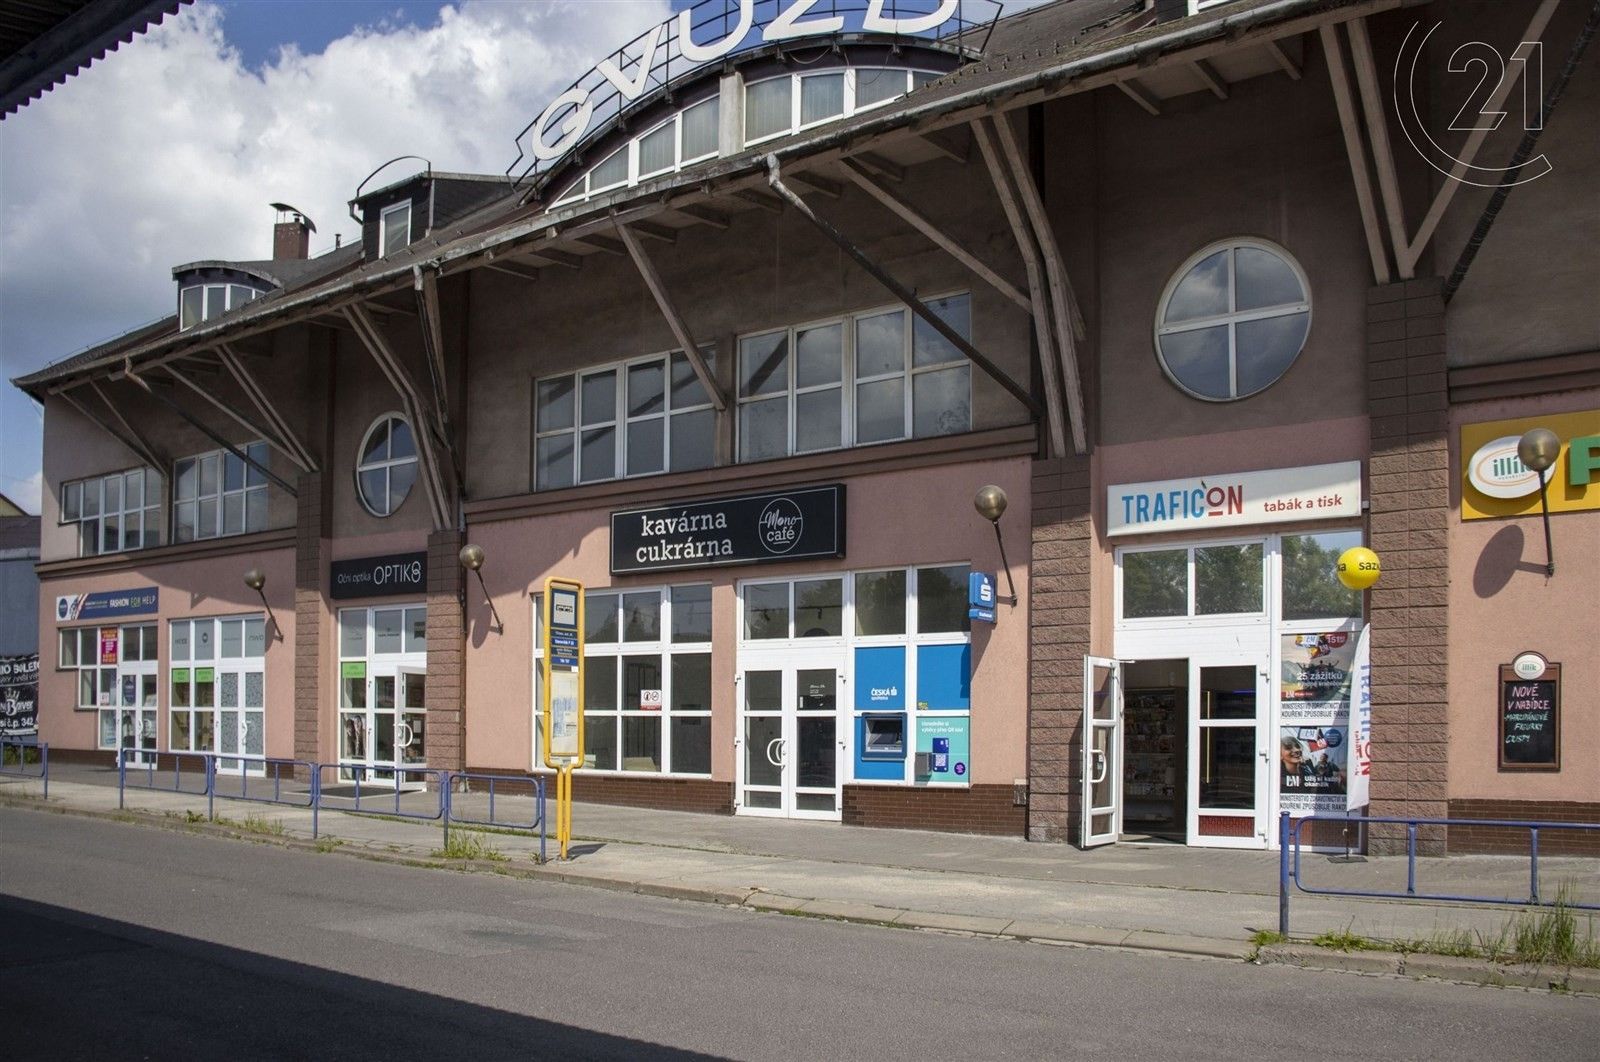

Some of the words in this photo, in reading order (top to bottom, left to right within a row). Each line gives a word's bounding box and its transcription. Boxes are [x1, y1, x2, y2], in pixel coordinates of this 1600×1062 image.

[1264, 498, 1302, 513] tabák
[1306, 500, 1314, 509] a
[1317, 494, 1343, 508] tisk
[641, 511, 727, 537] kavárna
[764, 509, 800, 530] Mono
[767, 528, 795, 541] café
[636, 538, 733, 563] cukrárna
[353, 570, 371, 584] optika
[110, 598, 129, 607] FASHION
[142, 595, 155, 604] HELP
[1296, 672, 1308, 681] 25
[1310, 671, 1343, 681] zážitků
[871, 687, 891, 696] ČESKÁ
[1507, 701, 1515, 711] V
[1515, 697, 1551, 710] NABÍDCE
[21, 716, 34, 726] 342
